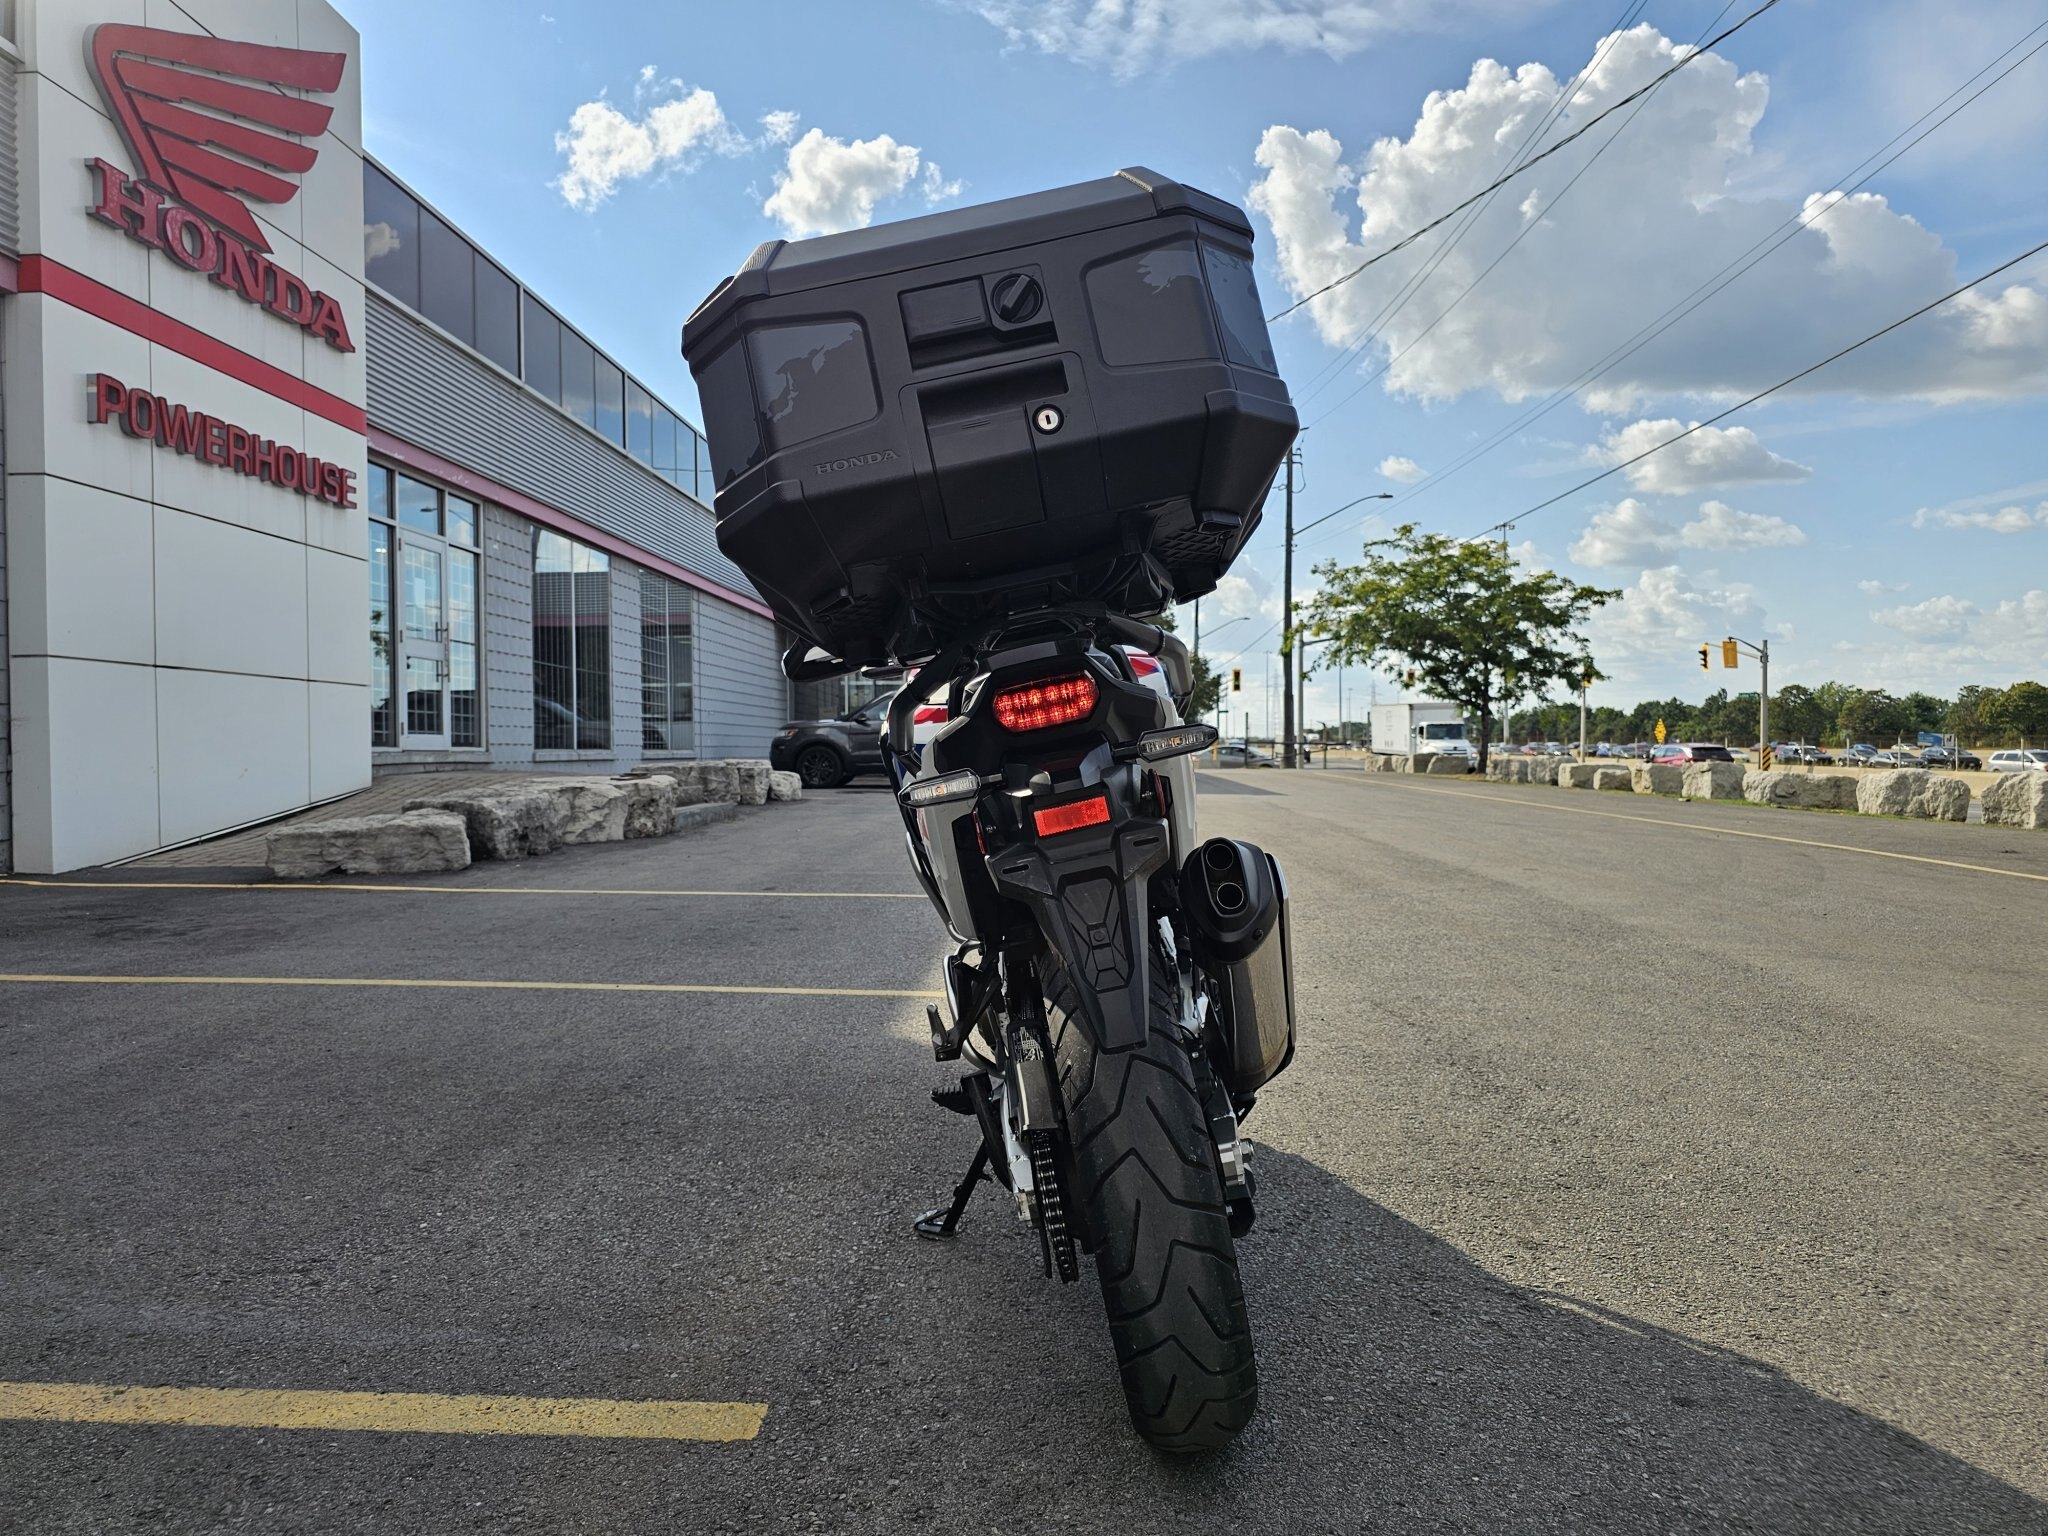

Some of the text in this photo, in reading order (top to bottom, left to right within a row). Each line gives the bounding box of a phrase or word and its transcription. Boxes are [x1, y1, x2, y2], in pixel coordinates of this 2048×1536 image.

[86, 157, 355, 352] HONDA
[88, 373, 357, 509] POWERHOUSE
[814, 449, 900, 474] HONDA
